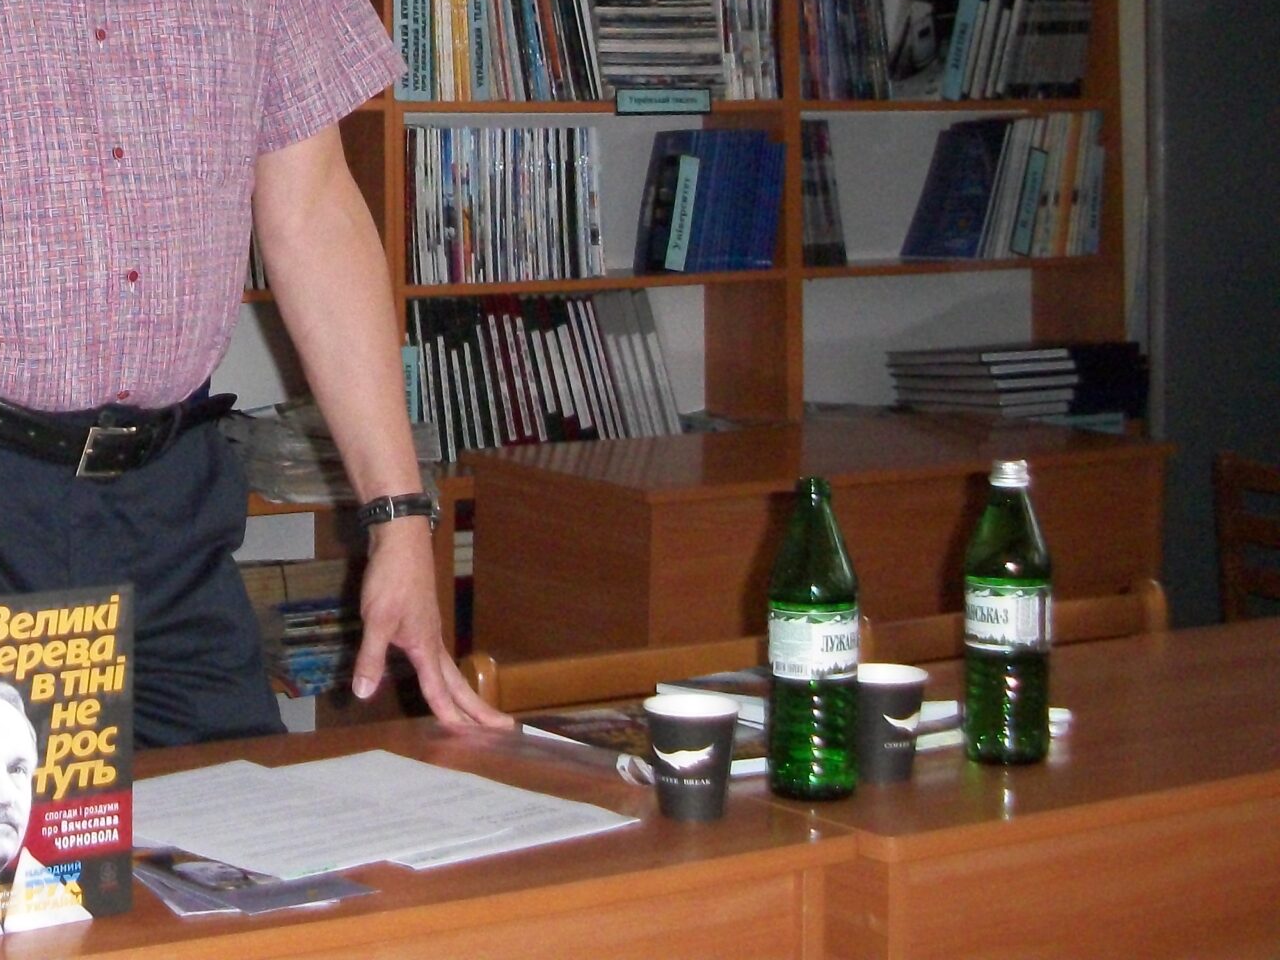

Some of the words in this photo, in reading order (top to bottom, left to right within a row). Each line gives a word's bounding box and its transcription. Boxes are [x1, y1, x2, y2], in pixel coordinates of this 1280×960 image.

[821, 635, 858, 653] ЛУЖАН
[31, 672, 54, 700] в
[61, 655, 126, 696] тіні
[50, 697, 100, 729] не
[45, 726, 118, 768] рос
[34, 762, 117, 800] туть
[683, 778, 711, 786] BREAK
[45, 810, 78, 822] спогади
[84, 802, 119, 818] роздуми
[42, 824, 58, 836] про
[61, 814, 119, 834] Вячеслава
[54, 829, 119, 850] ЧОРНОВОЛА
